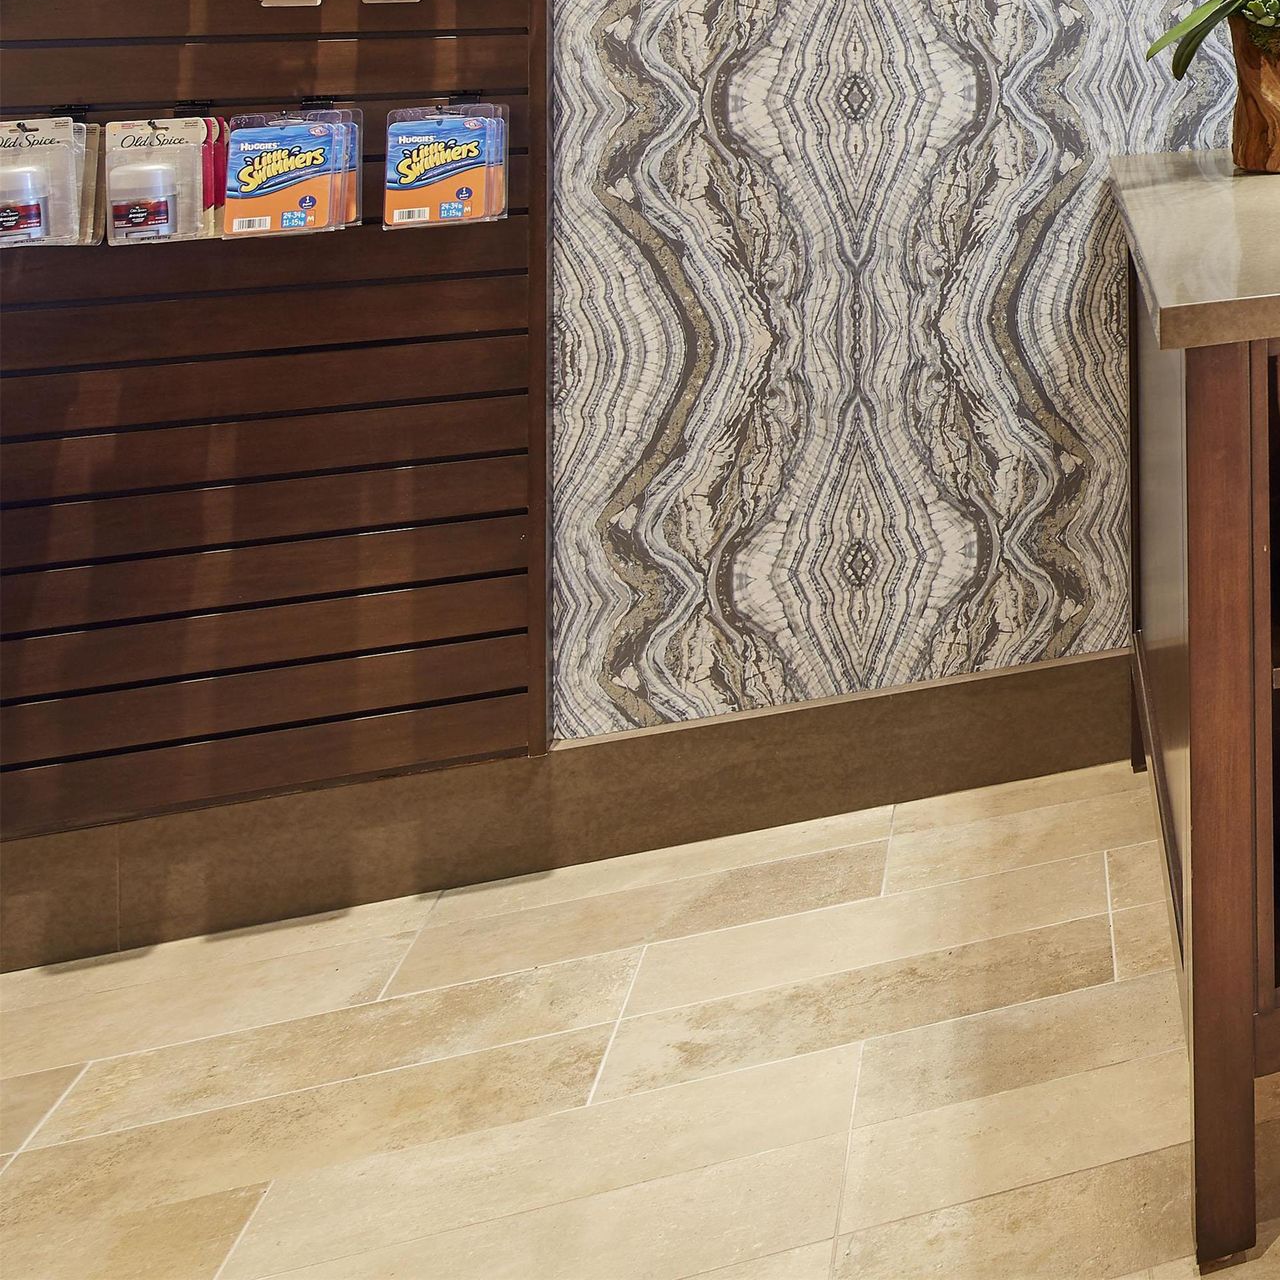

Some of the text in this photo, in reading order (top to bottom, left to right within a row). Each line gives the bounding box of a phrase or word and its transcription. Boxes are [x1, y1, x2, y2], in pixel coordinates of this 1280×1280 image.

[19, 134, 57, 148] Spice
[121, 133, 187, 149] Old Spice
[399, 135, 434, 144] HUGGIES
[241, 142, 278, 151] HUGGIES
